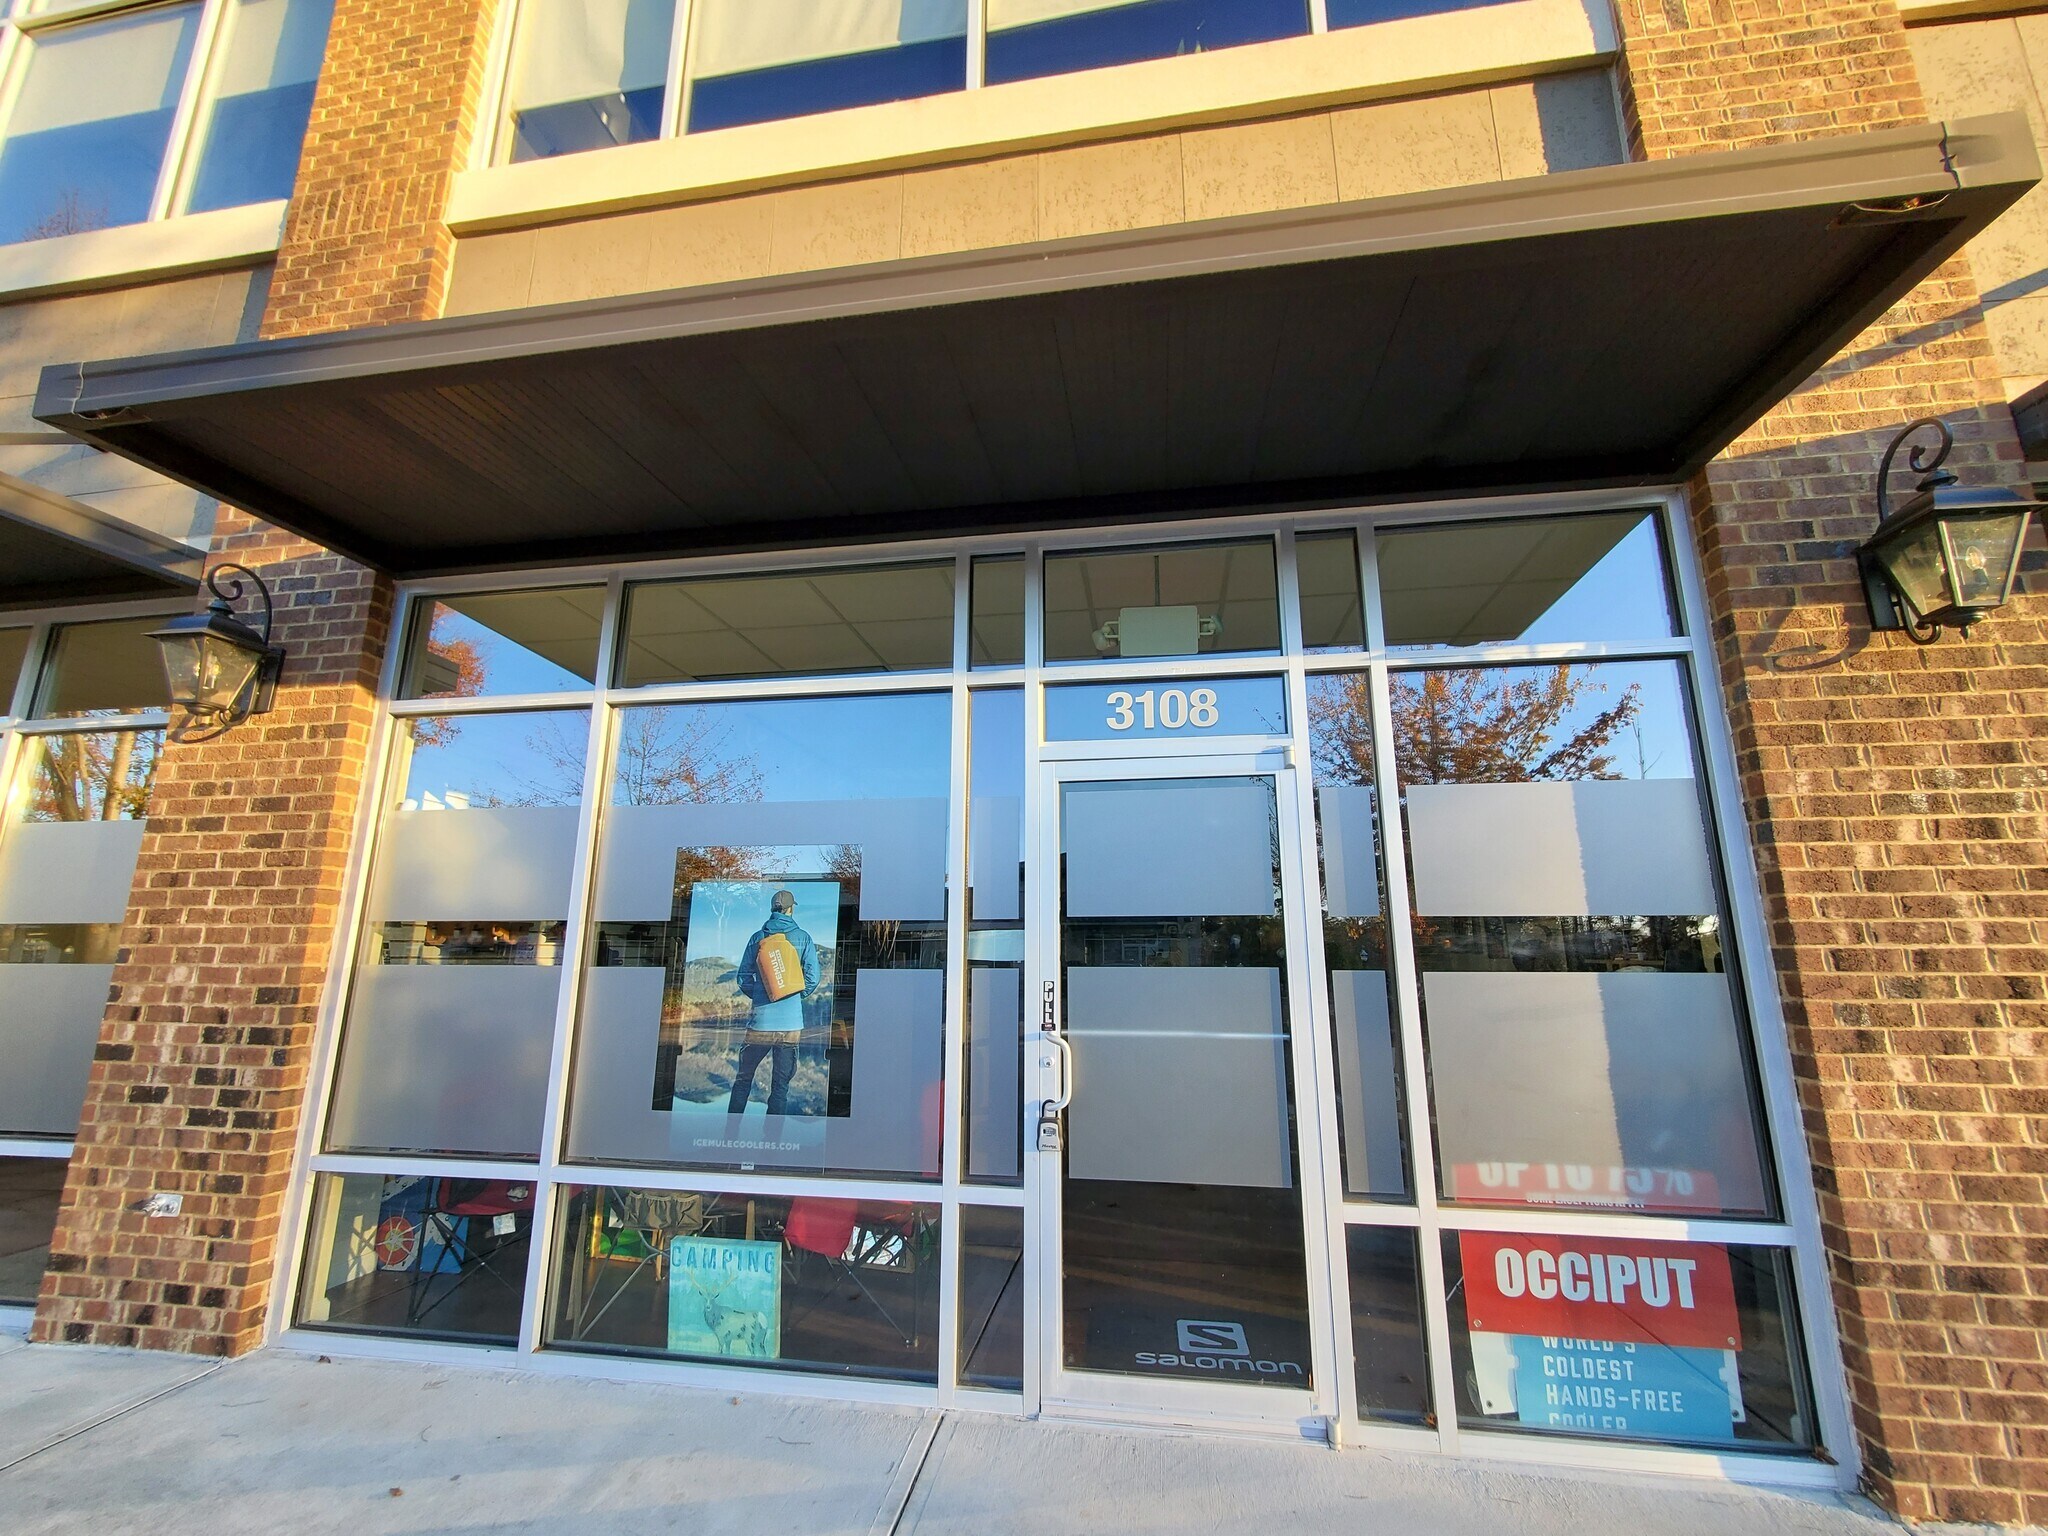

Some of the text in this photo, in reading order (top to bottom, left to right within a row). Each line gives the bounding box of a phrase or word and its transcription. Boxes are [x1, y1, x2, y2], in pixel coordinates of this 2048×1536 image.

[1106, 689, 1218, 729] 3108
[1044, 981, 1053, 1023] PULL
[693, 1139, 799, 1151] ICEMULECOOLERS.COM
[672, 1246, 774, 1273] CAMPING
[1495, 1248, 1696, 1309] OCCIPUT
[1543, 1355, 1633, 1381] COLDEST
[1546, 1384, 1683, 1412] HANDS-FREE
